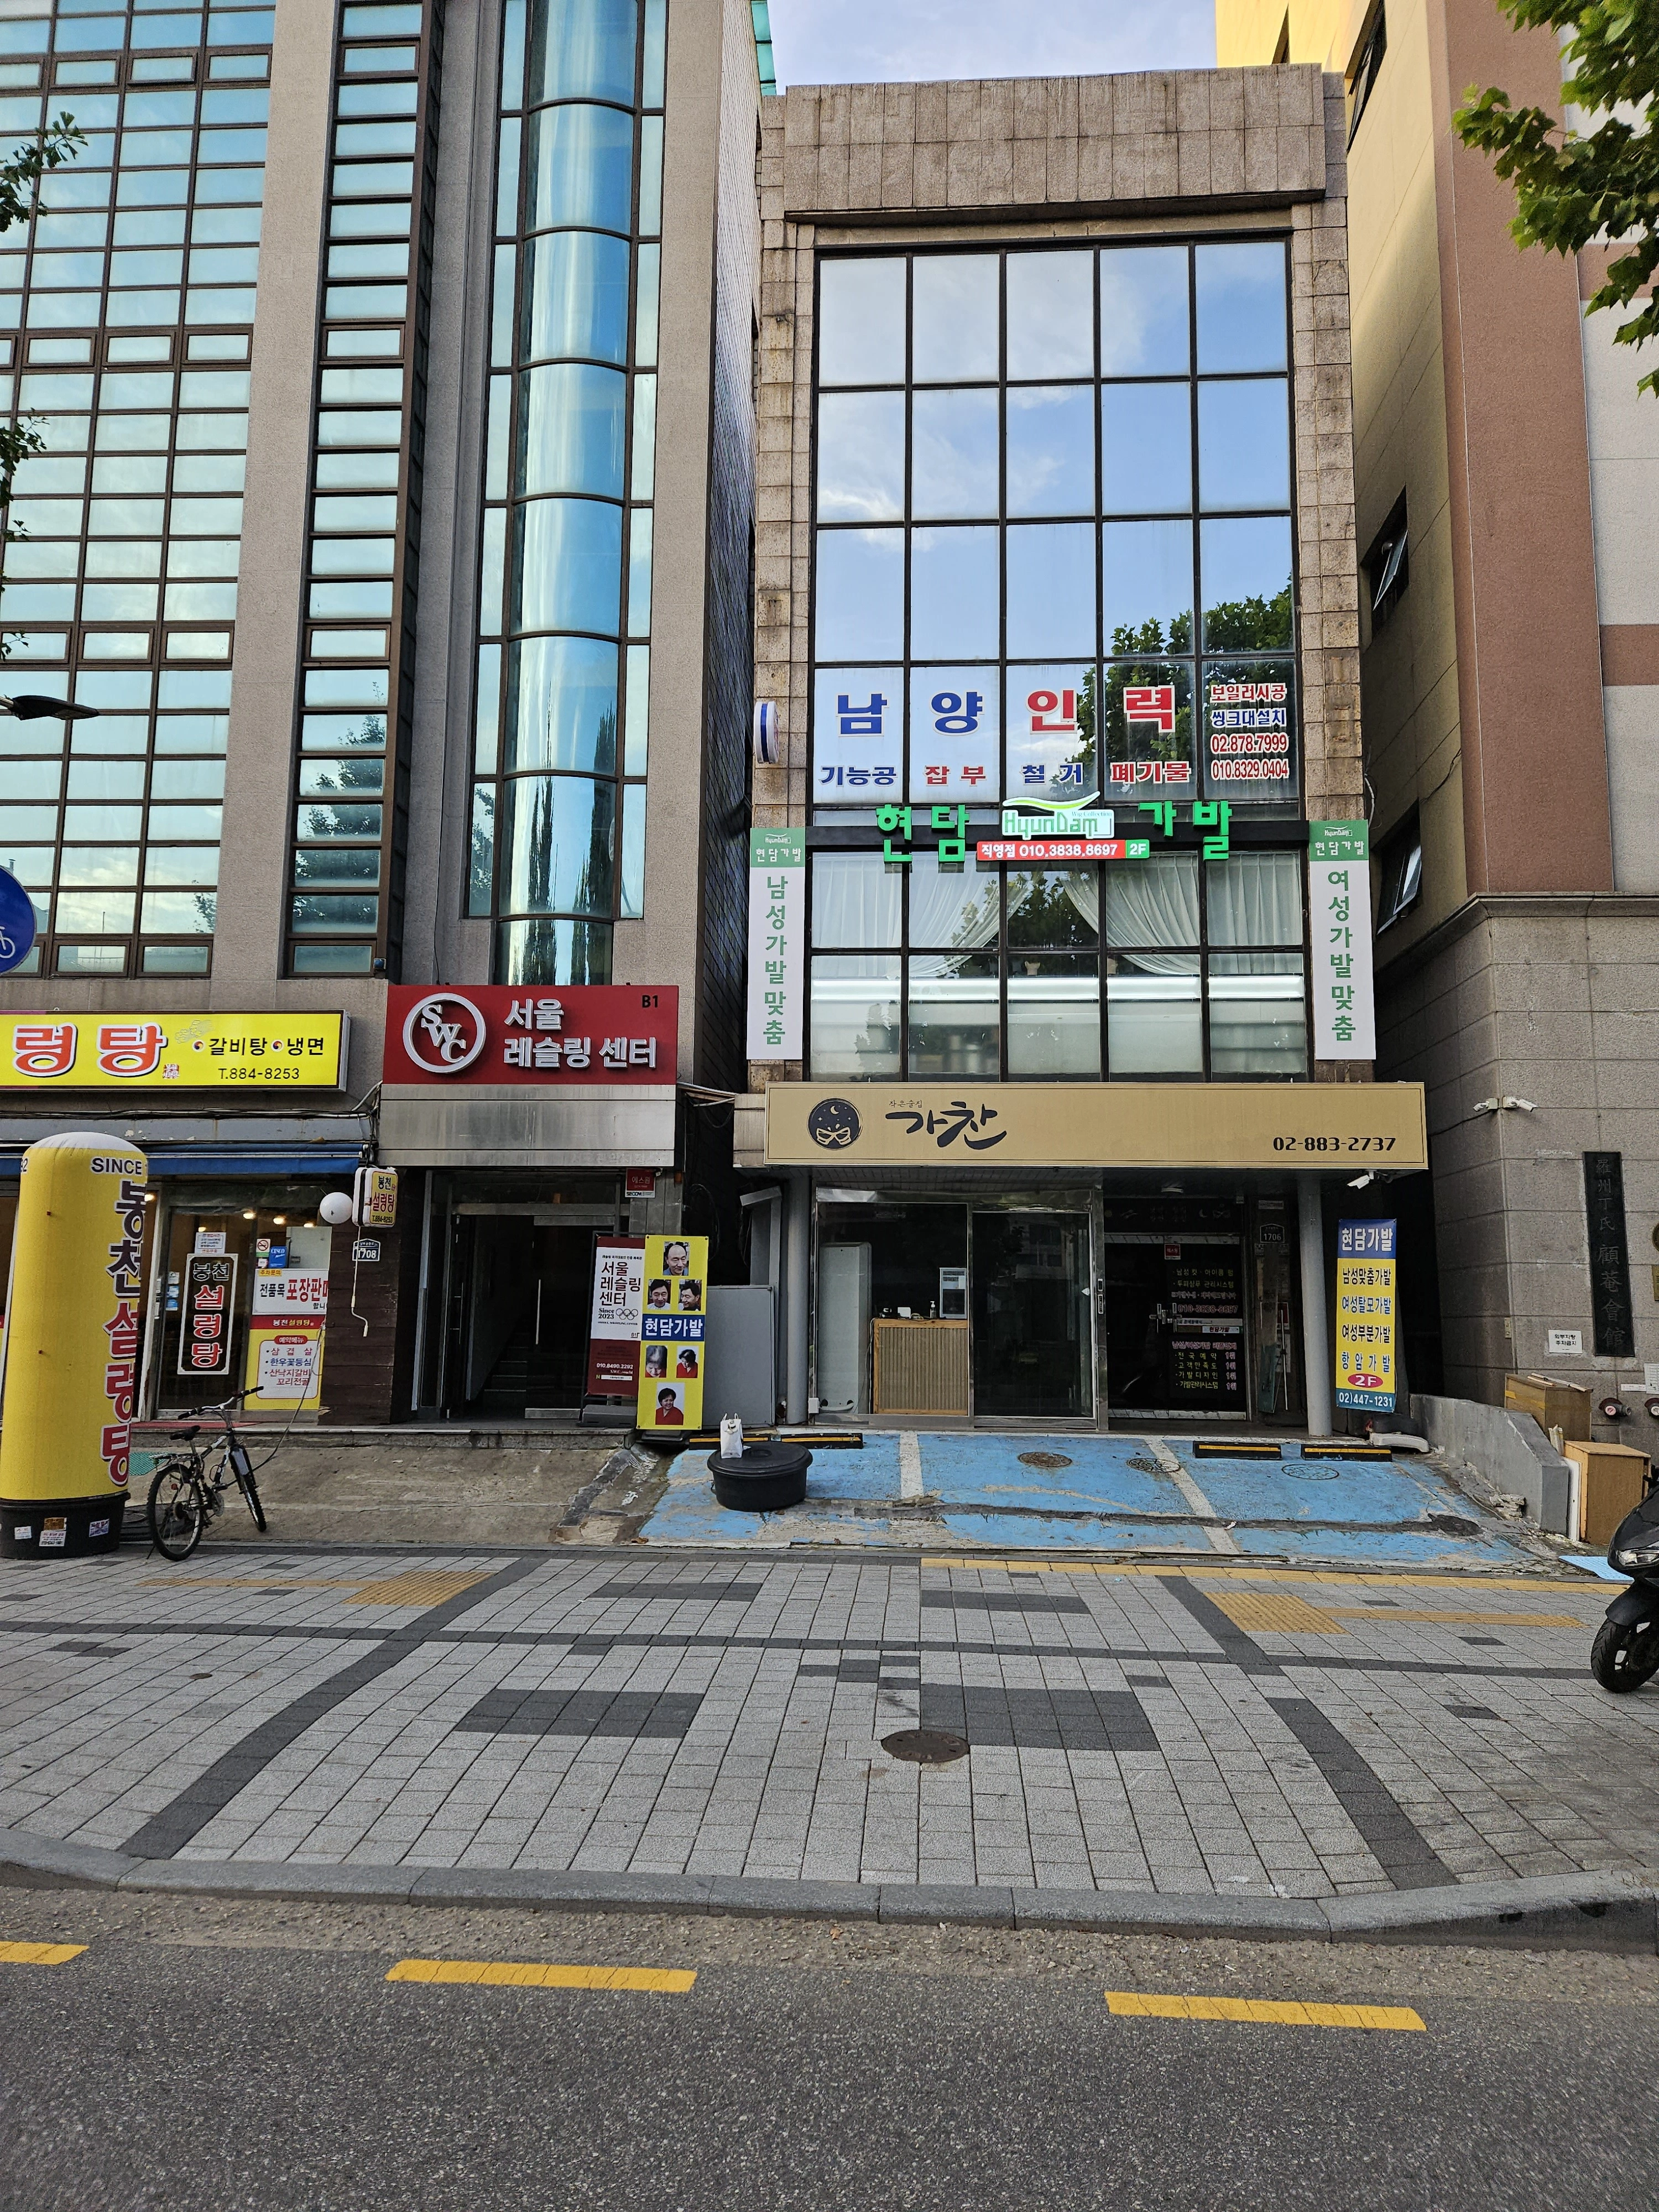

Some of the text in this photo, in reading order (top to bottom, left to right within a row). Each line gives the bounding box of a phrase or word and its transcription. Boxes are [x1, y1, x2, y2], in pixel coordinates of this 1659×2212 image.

[1211, 684, 1286, 702] 보일러시공
[1211, 708, 1286, 728] 씽크대설치
[1211, 733, 1288, 753] 02.878.7999
[820, 765, 897, 786] 기능공
[1111, 761, 1191, 783] 폐기물
[1212, 759, 1288, 780] 010.8329.0404
[1004, 812, 1098, 838] HyunDam
[756, 848, 801, 862] 현담가발
[982, 843, 1146, 859] 직영점 010.3838.8697 2F
[1314, 841, 1365, 855] 현담가발
[641, 995, 659, 1008] B1
[504, 998, 564, 1030] 서울
[208, 1037, 324, 1056] 갈비탕 냉면
[504, 1036, 657, 1069] 레슬링 센터
[218, 1068, 300, 1080] T.884-8253
[885, 1101, 1007, 1150] 가찬
[1272, 1136, 1396, 1152] 02-883-2737
[91, 1157, 142, 1175] SINCE
[378, 1175, 392, 1190] 봉천
[632, 1176, 650, 1184] 에스원
[373, 1191, 395, 1213] 설렁탕
[1341, 1228, 1394, 1251] 현담가발
[358, 1249, 377, 1258] 1708
[193, 1262, 229, 1281] 봉천
[601, 1261, 629, 1276] 서울
[1342, 1267, 1391, 1287] 남성맞춤가발
[259, 1283, 285, 1298] 전품목
[601, 1276, 641, 1292] 레슬링
[599, 1291, 627, 1307] 센터
[1342, 1296, 1391, 1315] 여성탈모가발
[191, 1285, 225, 1368] 설렁탕
[644, 1317, 703, 1338] 현담가발
[1342, 1324, 1391, 1344] 여성부분가발
[270, 1358, 311, 1366] 한우꽃등심
[269, 1368, 311, 1377] 산낙지갈비
[276, 1377, 309, 1386] 꼬리전골
[1354, 1375, 1378, 1387] 2F
[1339, 1392, 1393, 1408] 02)447-1231
